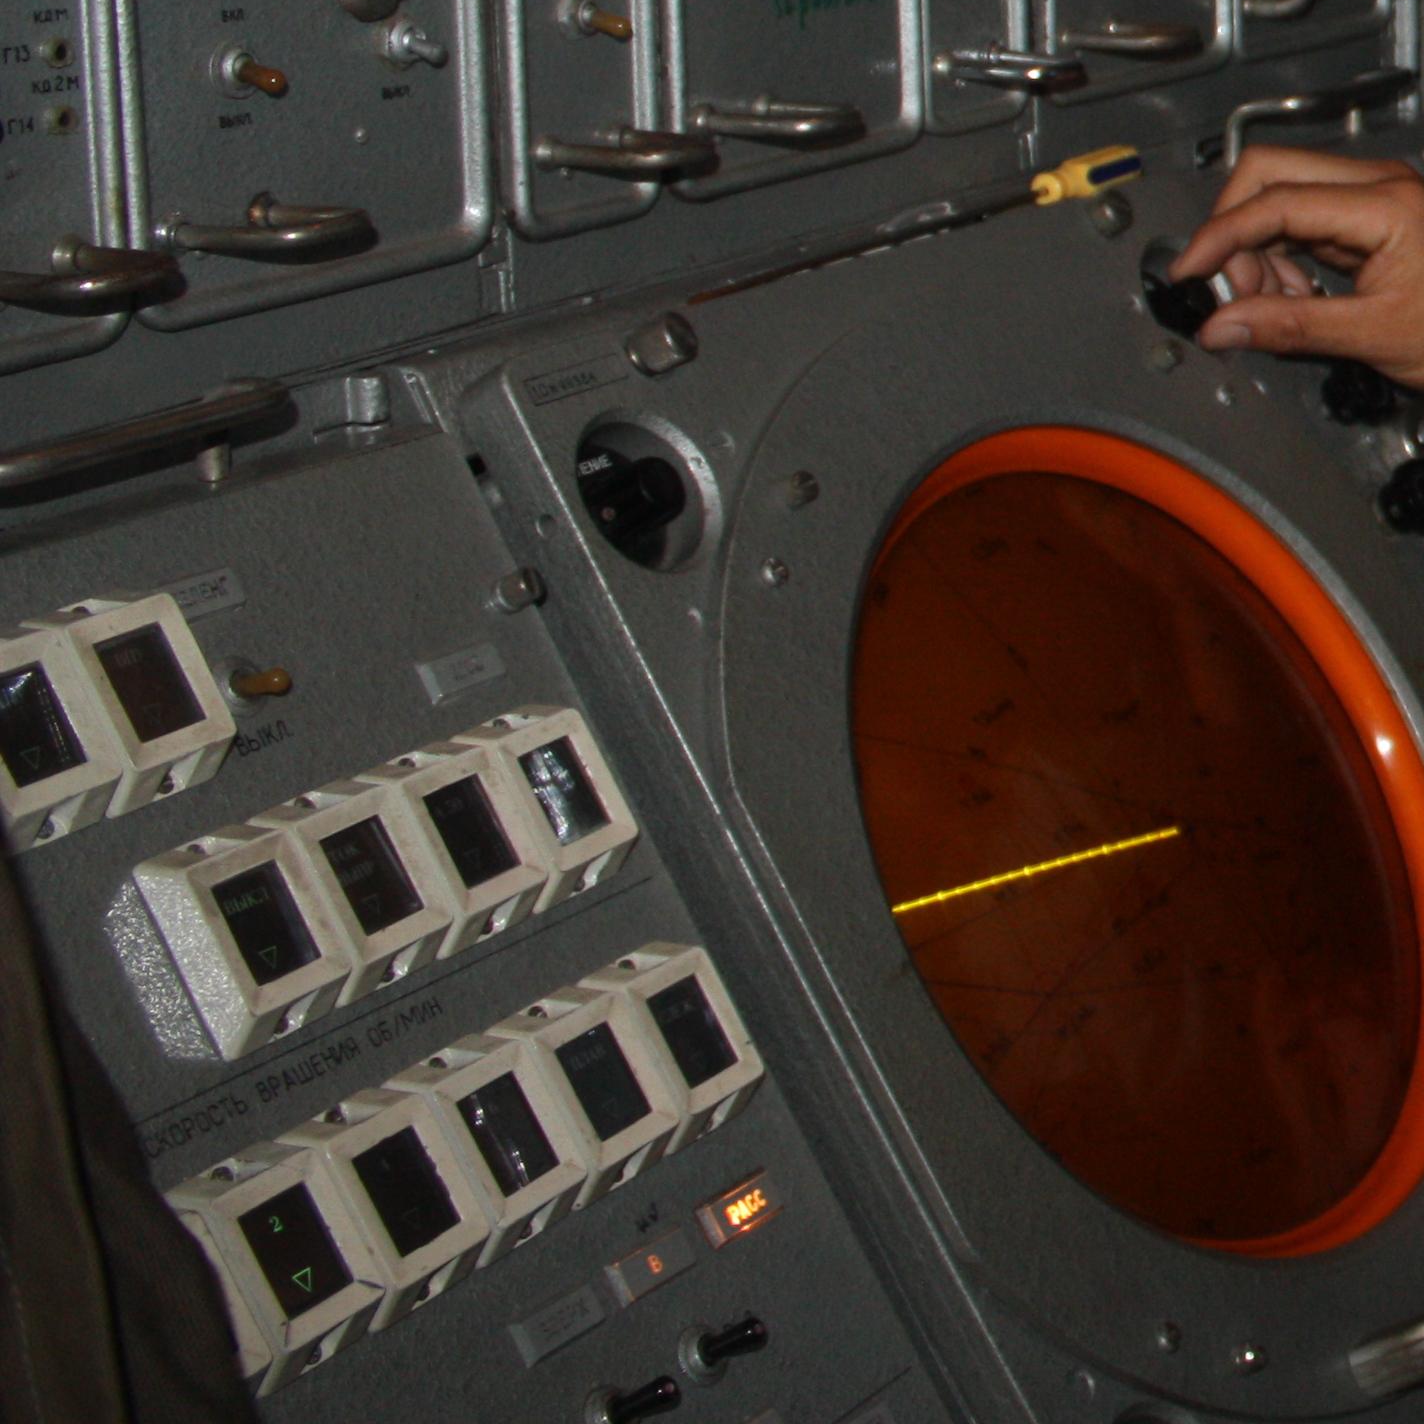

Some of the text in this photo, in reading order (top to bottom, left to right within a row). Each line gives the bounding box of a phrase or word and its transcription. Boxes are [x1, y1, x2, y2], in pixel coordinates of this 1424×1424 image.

[2, 44, 31, 64] Г13
[7, 116, 35, 136] Г14
[235, 720, 296, 757] ВЫКЛ
[145, 1095, 249, 1160] СКОРОСТЬ
[367, 996, 445, 1050] ОБ/МИН
[725, 1188, 768, 1227] РАСС
[268, 1215, 284, 1233] 2
